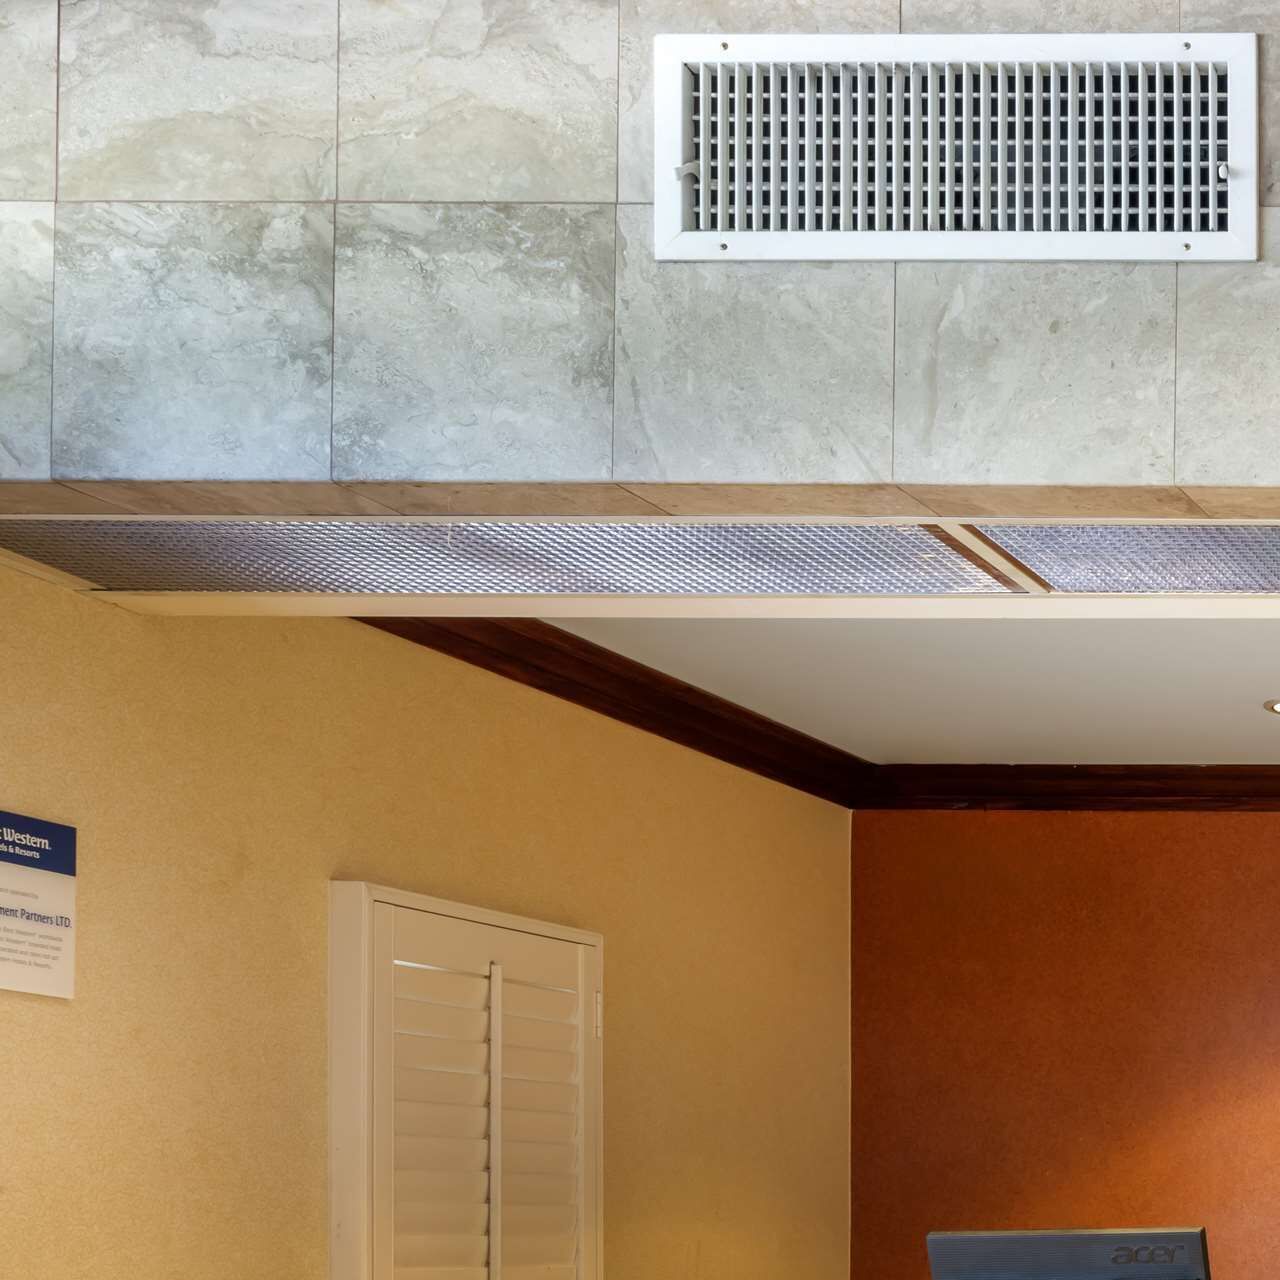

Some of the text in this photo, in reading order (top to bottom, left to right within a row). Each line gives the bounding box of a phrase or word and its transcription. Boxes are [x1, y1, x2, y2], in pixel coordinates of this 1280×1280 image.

[3, 828, 49, 850] Western
[15, 847, 40, 859] Resorts
[20, 908, 53, 925] Partners
[1111, 1246, 1184, 1264] acer
